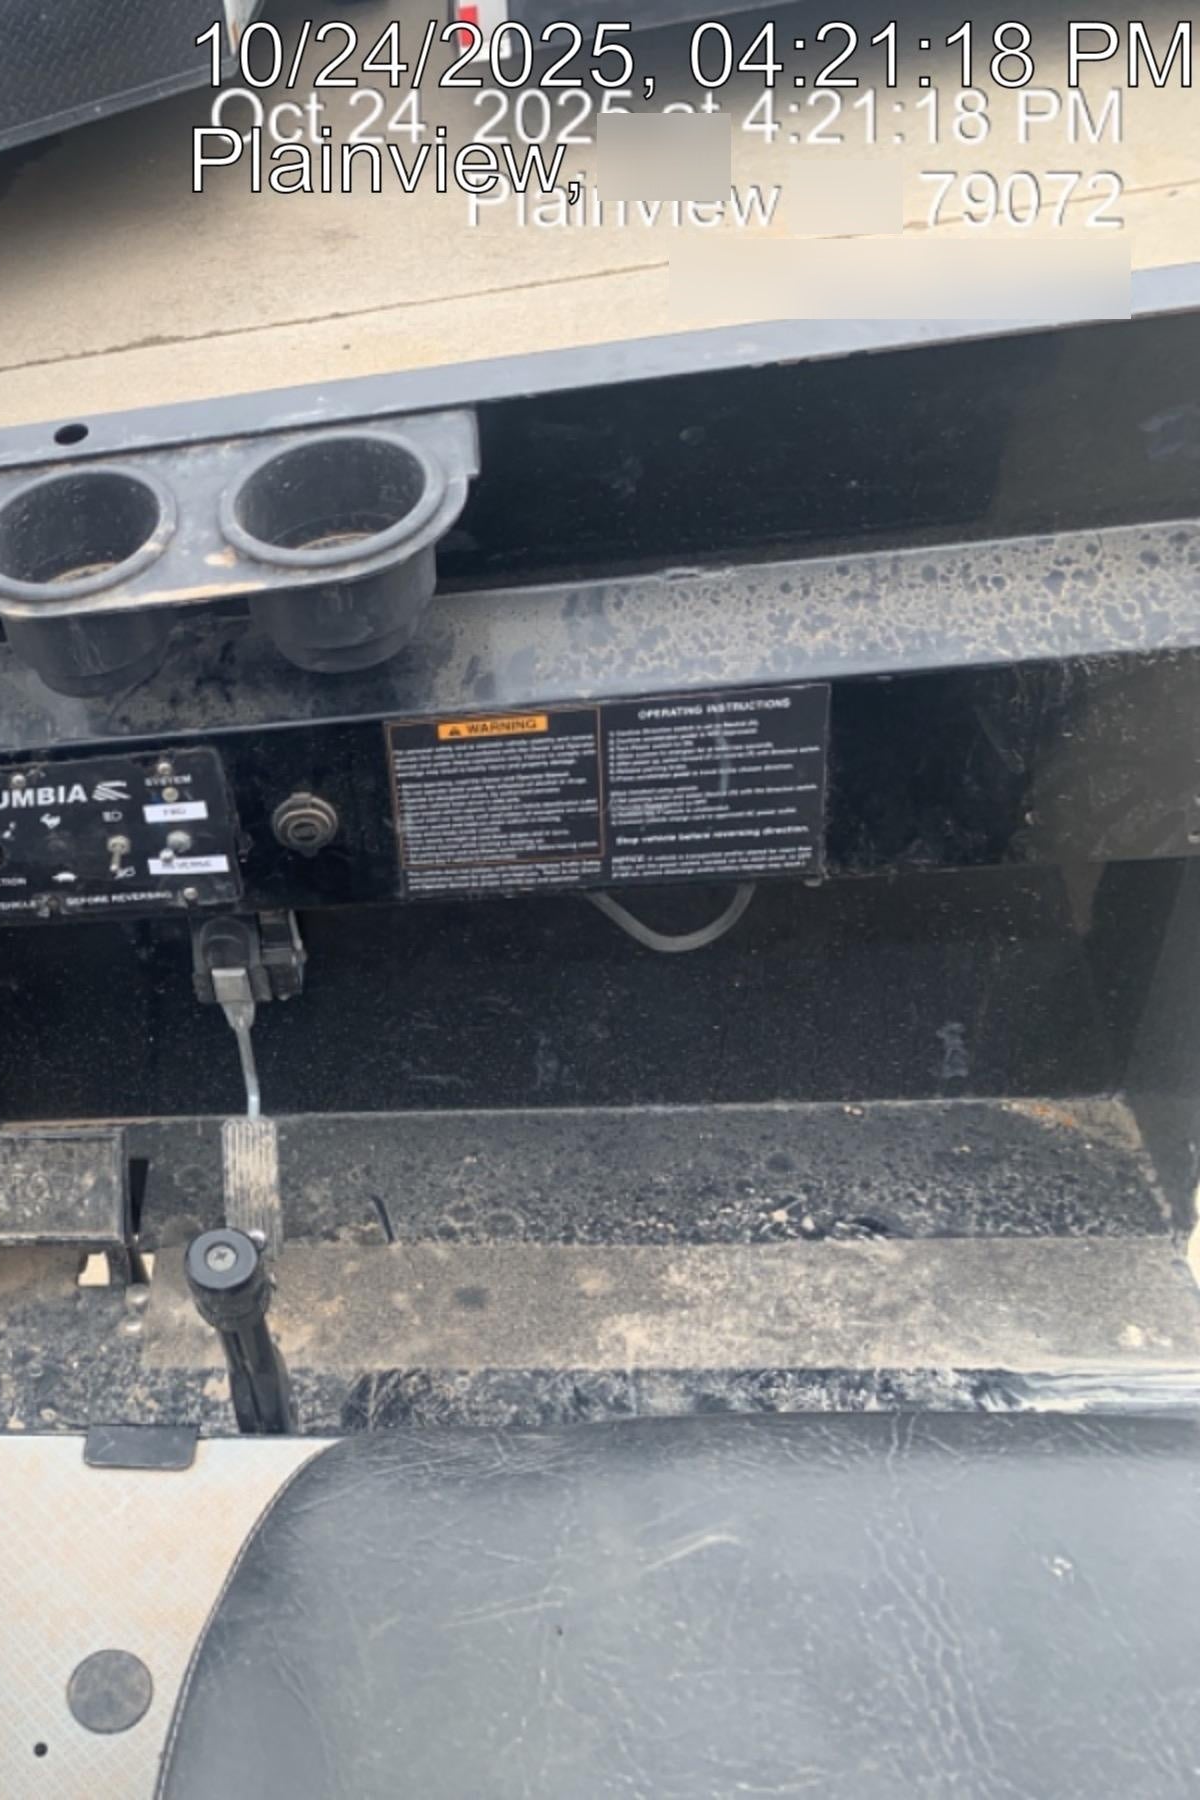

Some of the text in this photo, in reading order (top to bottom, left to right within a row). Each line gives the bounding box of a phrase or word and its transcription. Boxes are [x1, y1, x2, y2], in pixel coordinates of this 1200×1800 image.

[638, 697, 791, 721] OPERATING INSTRUCTIONS
[468, 720, 537, 734] WARNING
